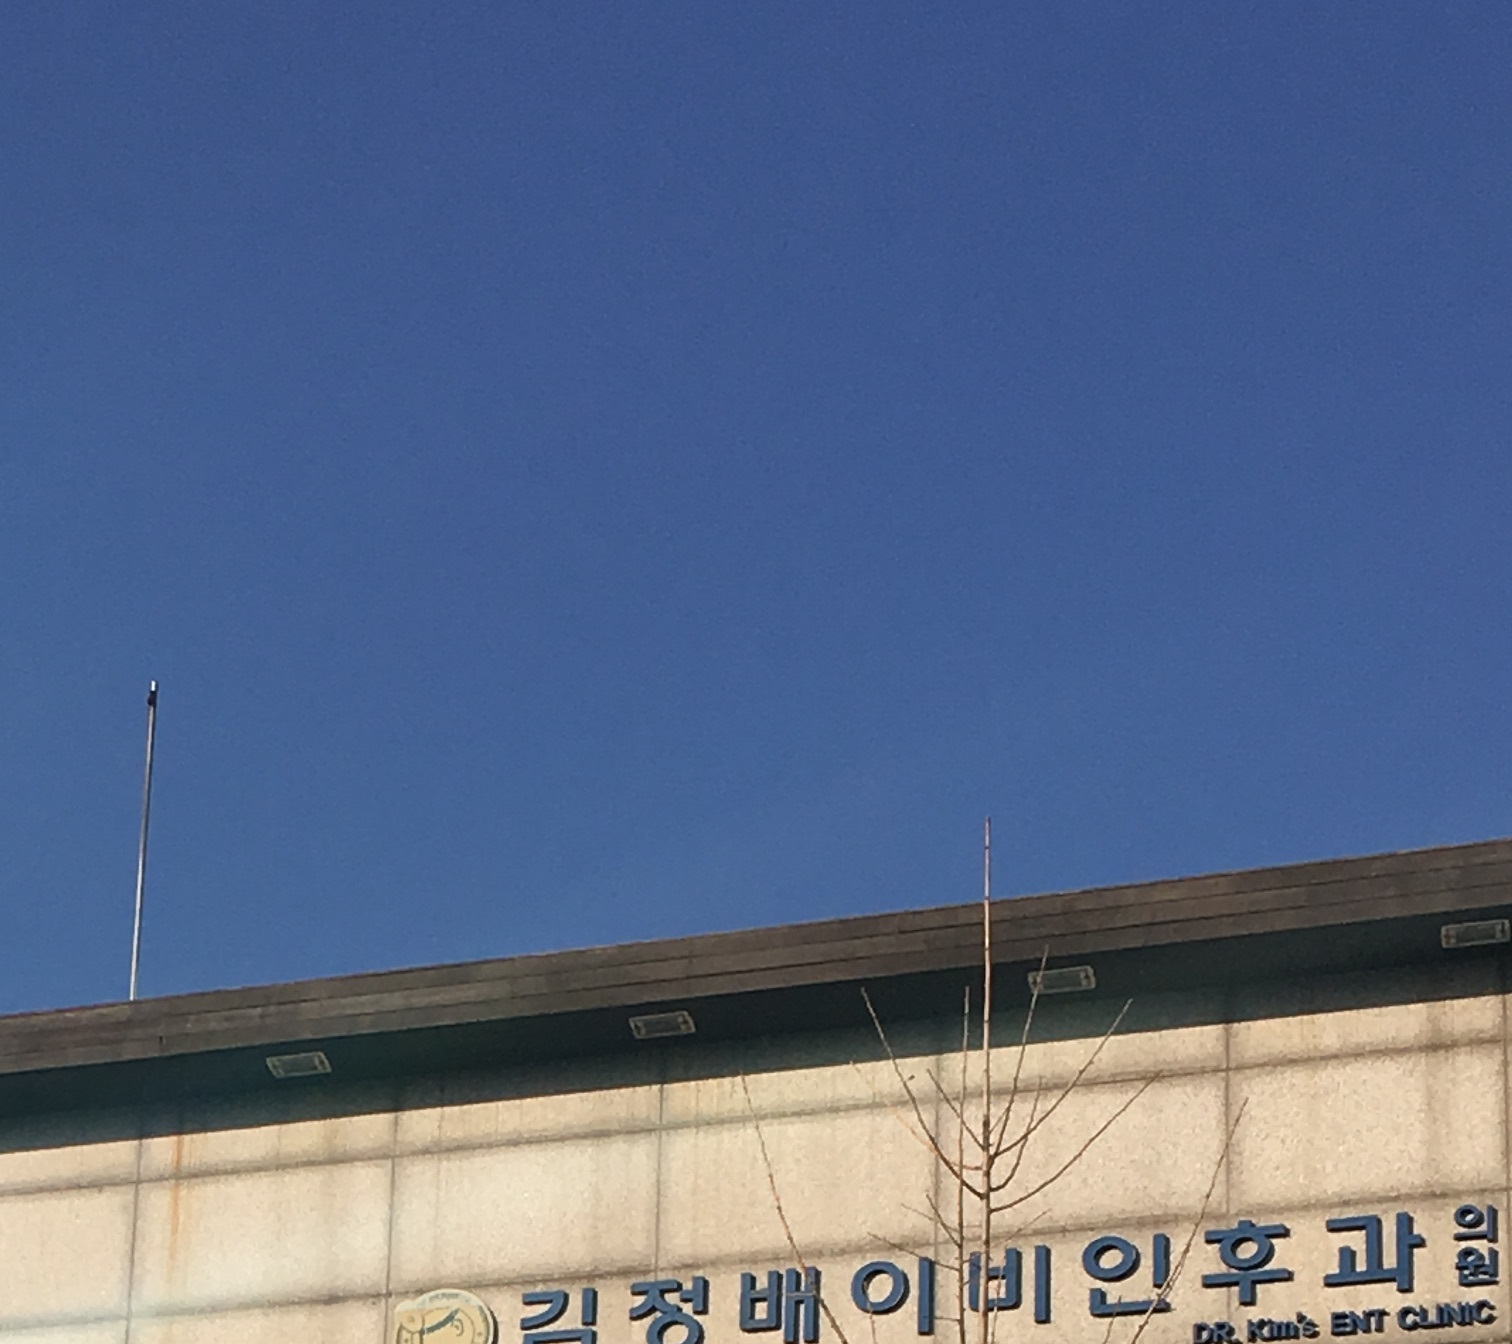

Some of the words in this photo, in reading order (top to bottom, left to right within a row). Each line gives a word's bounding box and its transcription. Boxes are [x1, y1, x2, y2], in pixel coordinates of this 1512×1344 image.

[1246, 1311, 1321, 1343] Kim's
[1330, 1308, 1391, 1336] ENT
[1397, 1299, 1498, 1331] CLINIC
